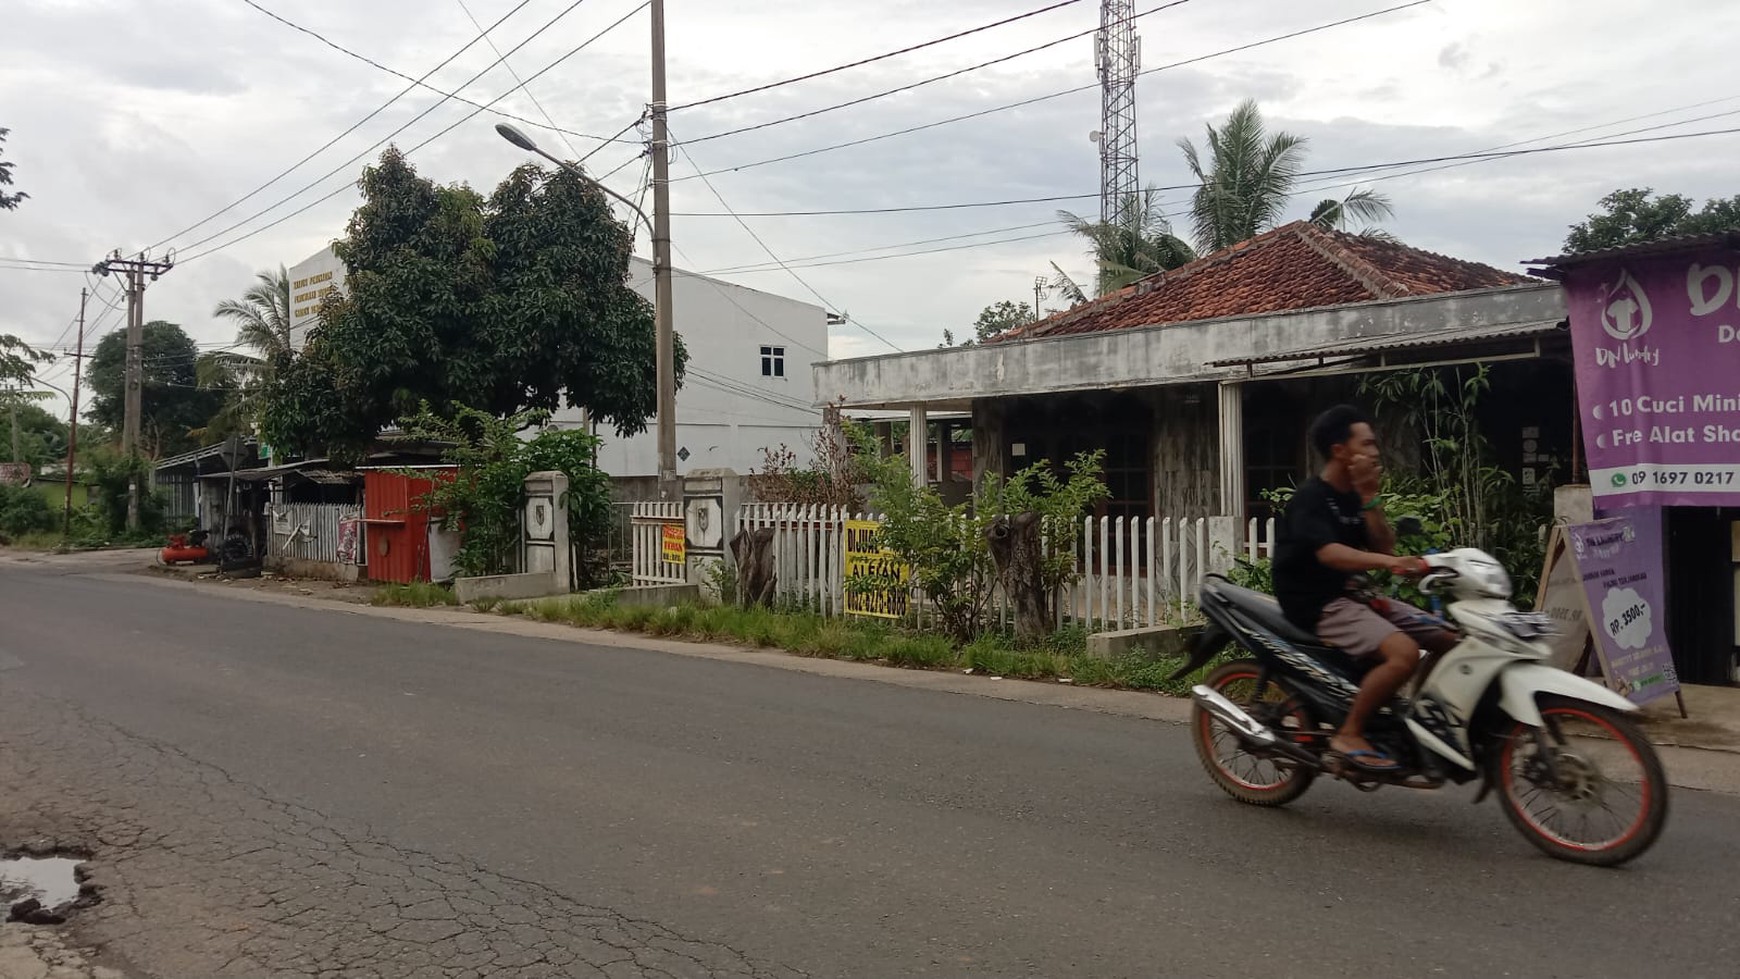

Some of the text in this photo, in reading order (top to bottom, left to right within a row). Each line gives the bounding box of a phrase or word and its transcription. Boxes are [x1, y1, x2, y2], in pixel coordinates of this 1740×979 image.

[1687, 263, 1740, 316] D
[1718, 325, 1740, 343] D
[1595, 346, 1620, 369] DN
[1609, 399, 1632, 417] 10
[1637, 396, 1684, 413] Cuci
[1650, 426, 1695, 443] Alat
[1632, 471, 1734, 485] 09 1697 0217
